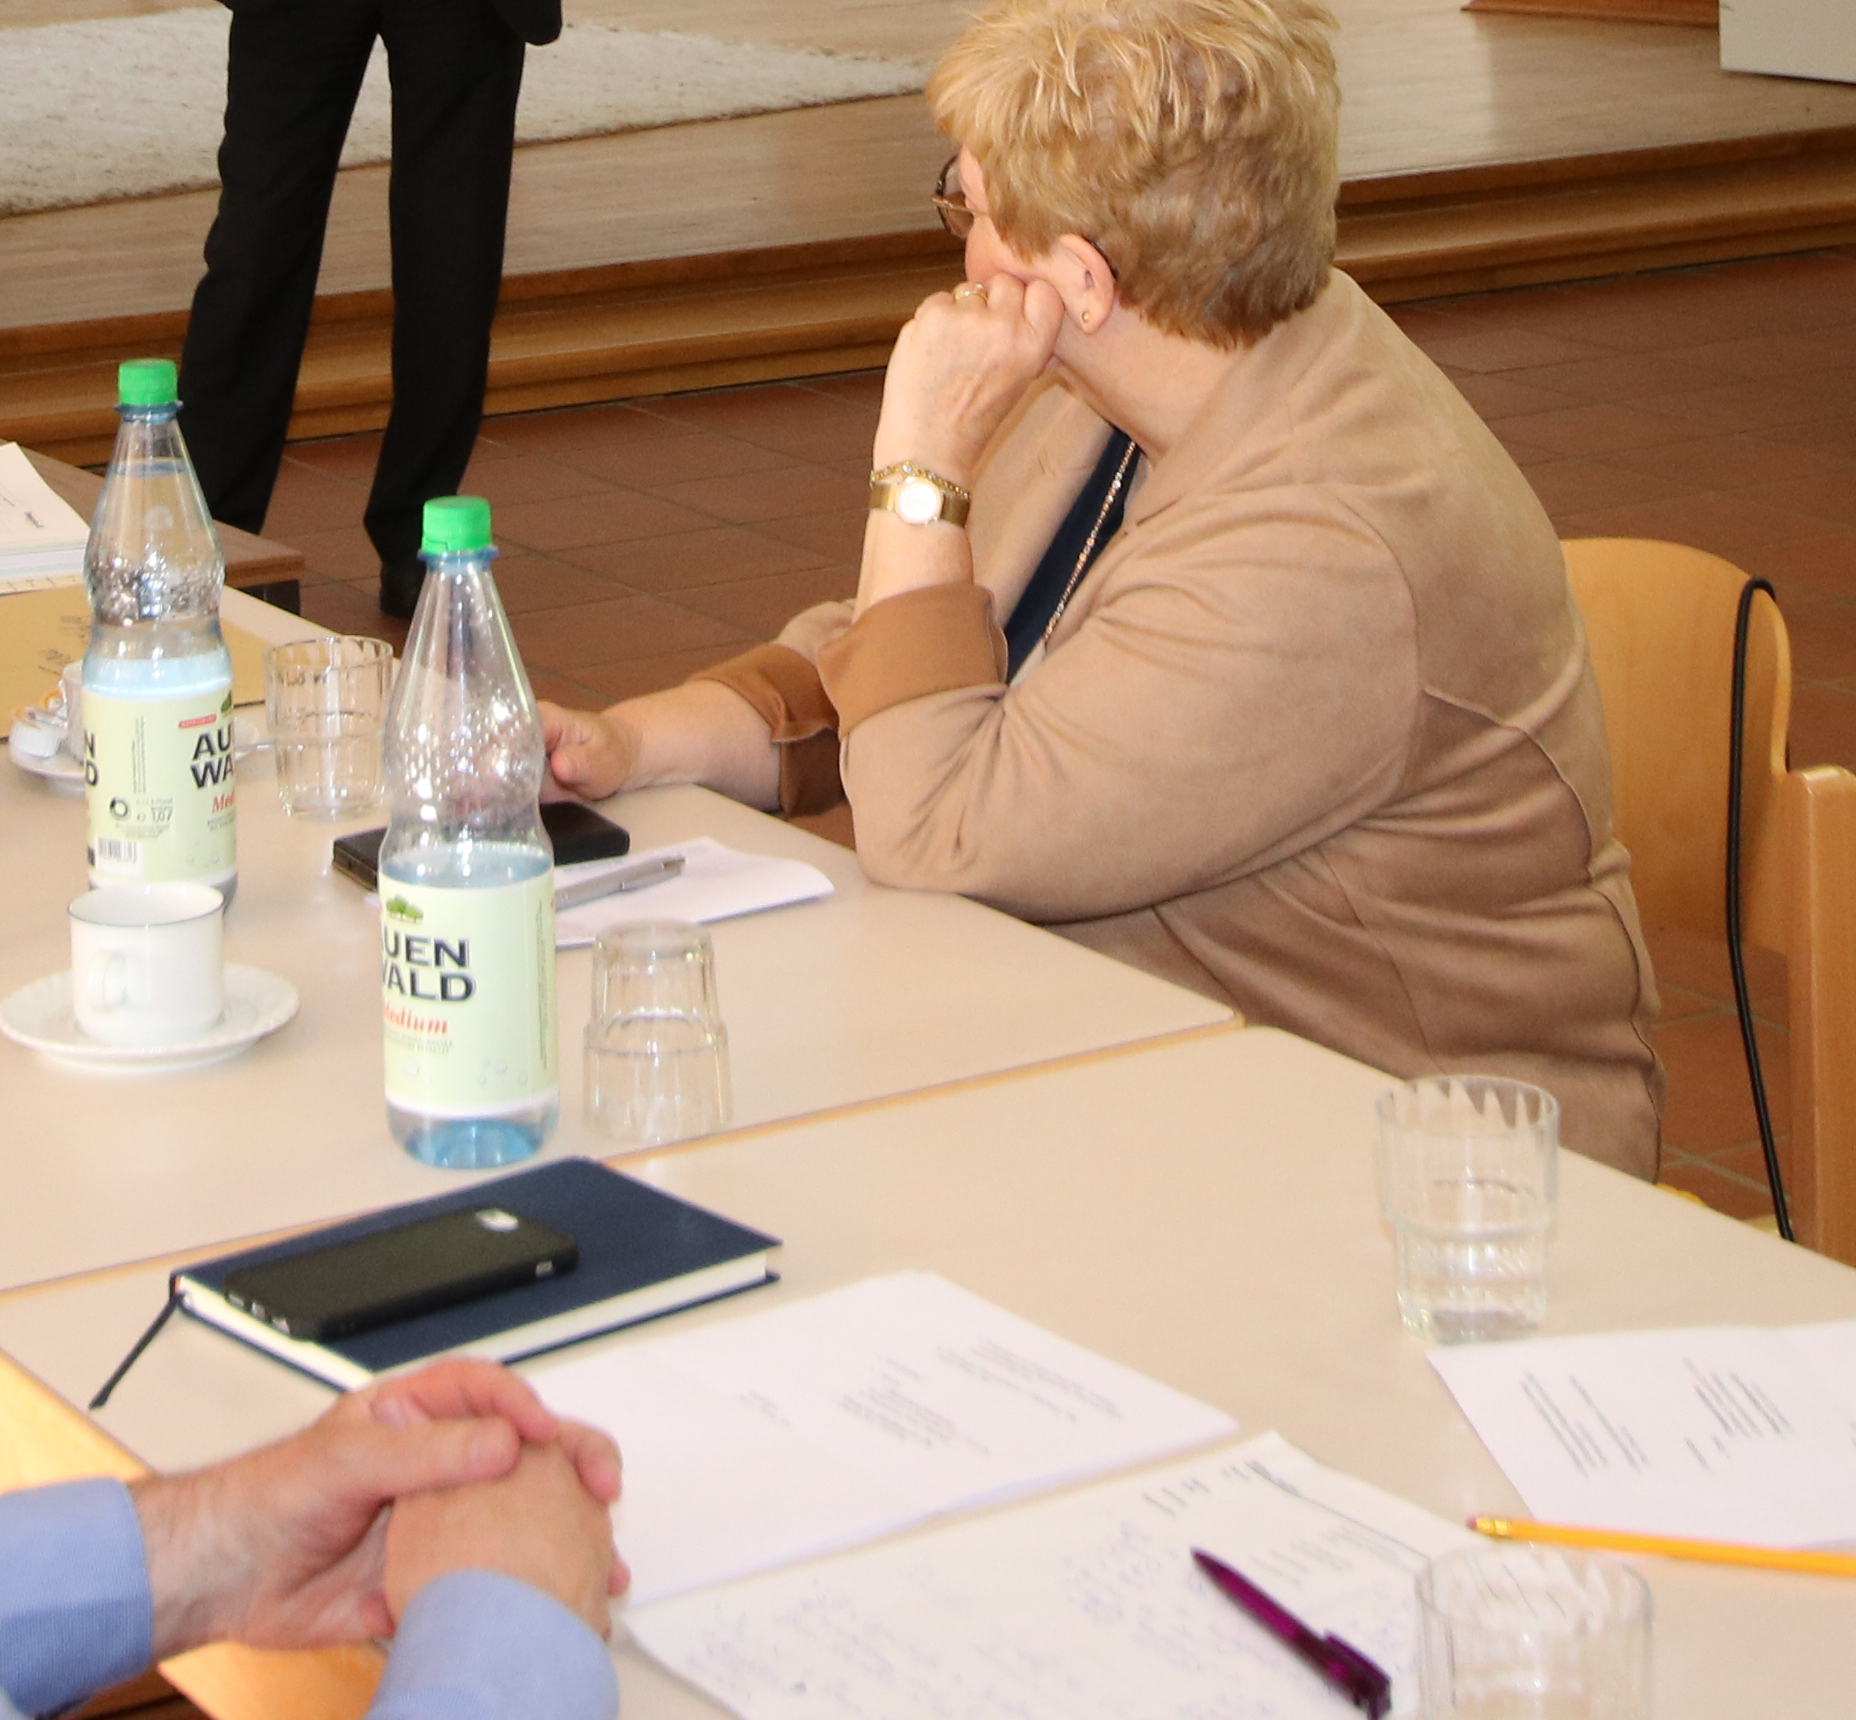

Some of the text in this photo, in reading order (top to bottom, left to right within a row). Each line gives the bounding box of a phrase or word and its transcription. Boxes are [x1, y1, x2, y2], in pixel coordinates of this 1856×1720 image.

[192, 722, 234, 761] AU
[190, 753, 235, 790] WA
[383, 926, 470, 968] UEN
[382, 961, 477, 1002] ALD
